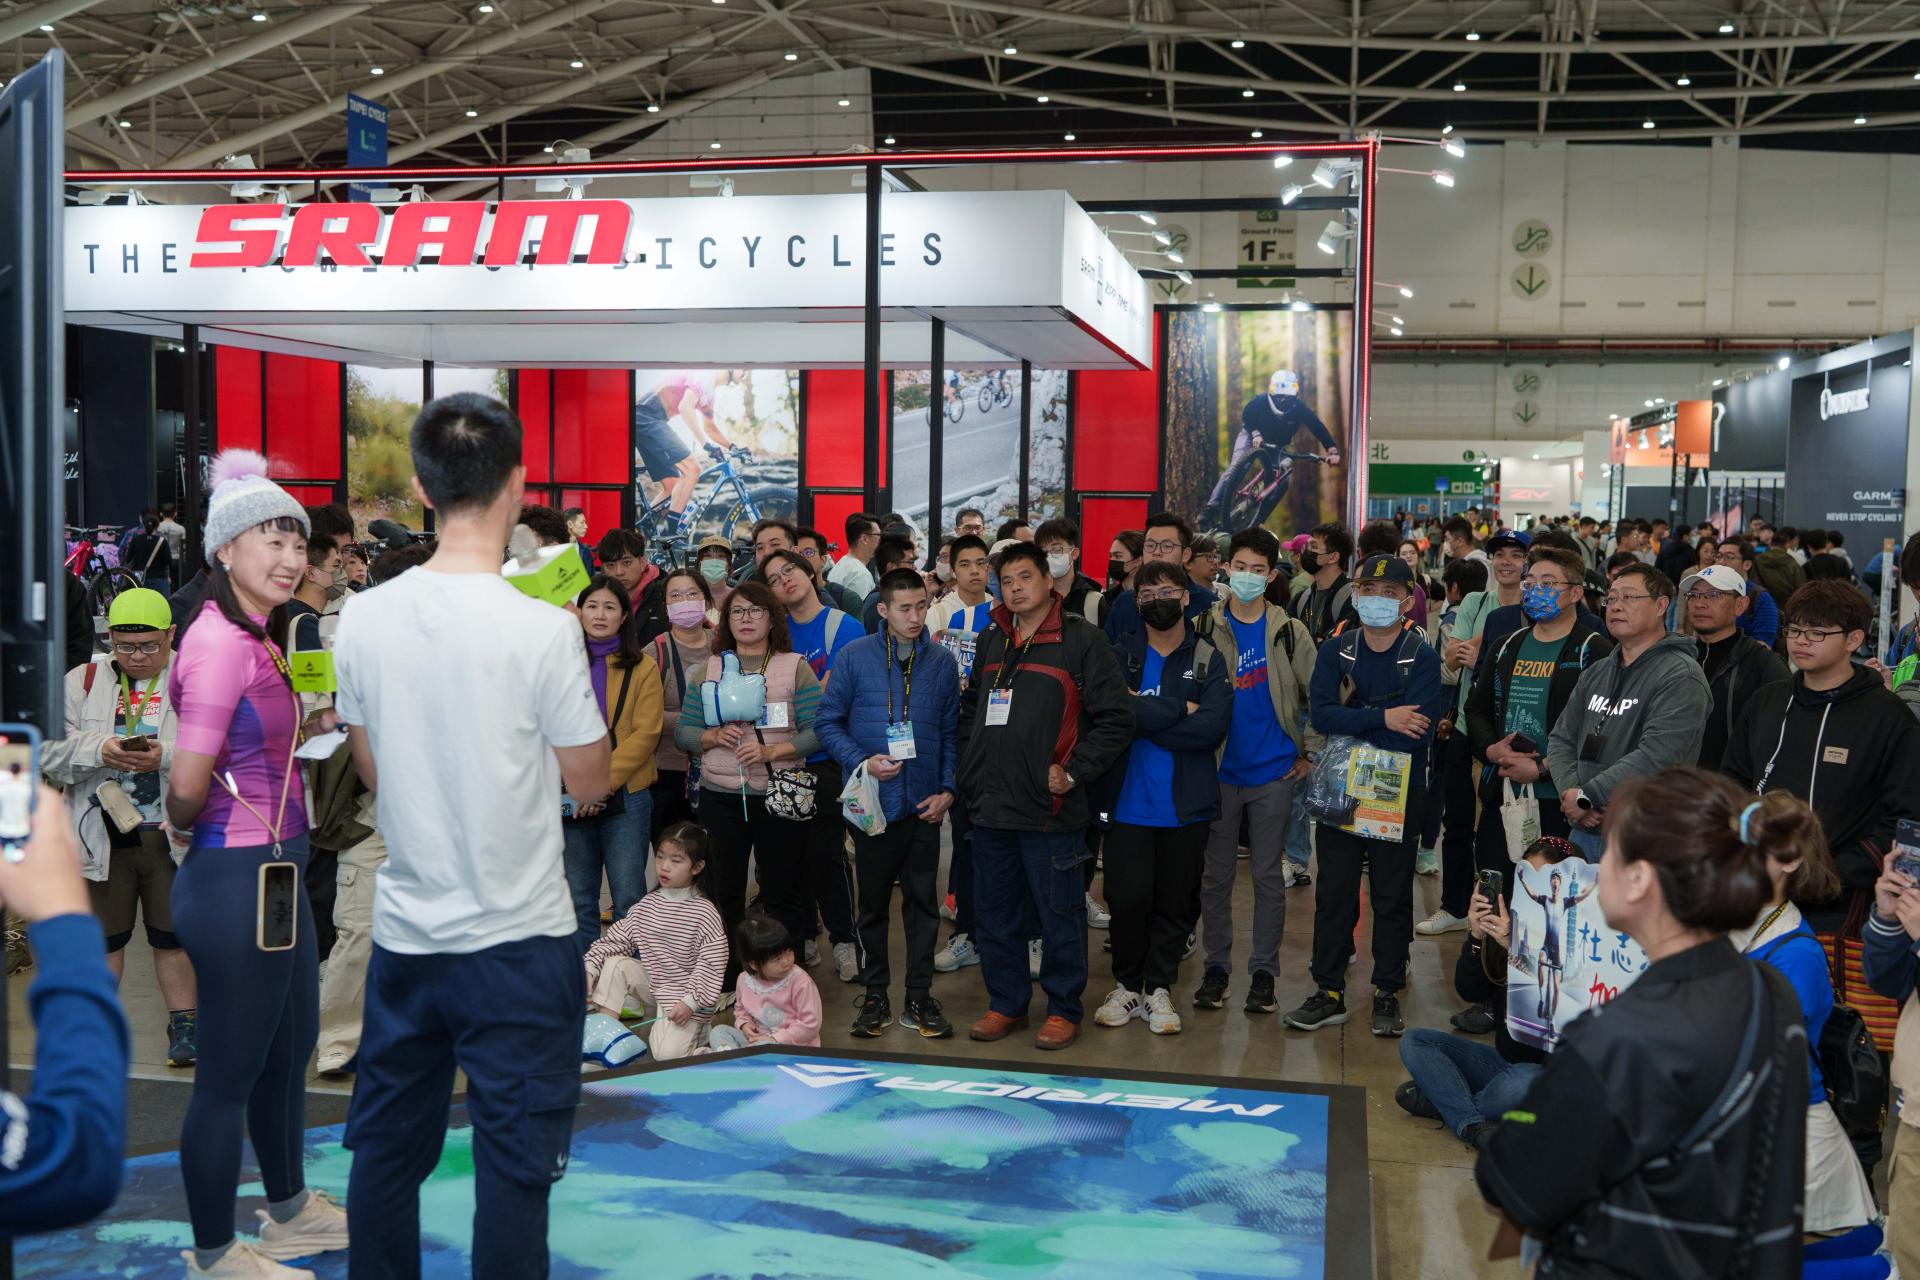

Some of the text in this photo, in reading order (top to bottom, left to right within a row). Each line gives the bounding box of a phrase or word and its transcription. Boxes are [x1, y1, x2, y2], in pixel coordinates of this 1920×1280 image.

[190, 199, 633, 268] SRAM
[84, 243, 178, 274] THE
[611, 232, 942, 270] ICYCLES
[1242, 241, 1277, 261] 1F
[1371, 443, 1389, 460] 北
[1853, 491, 1892, 500] GARM
[1826, 512, 1848, 521] NEVER
[1849, 513, 1867, 522] STOP
[1578, 921, 1651, 974] 杜志
[875, 1076, 1284, 1118] MERIDA
